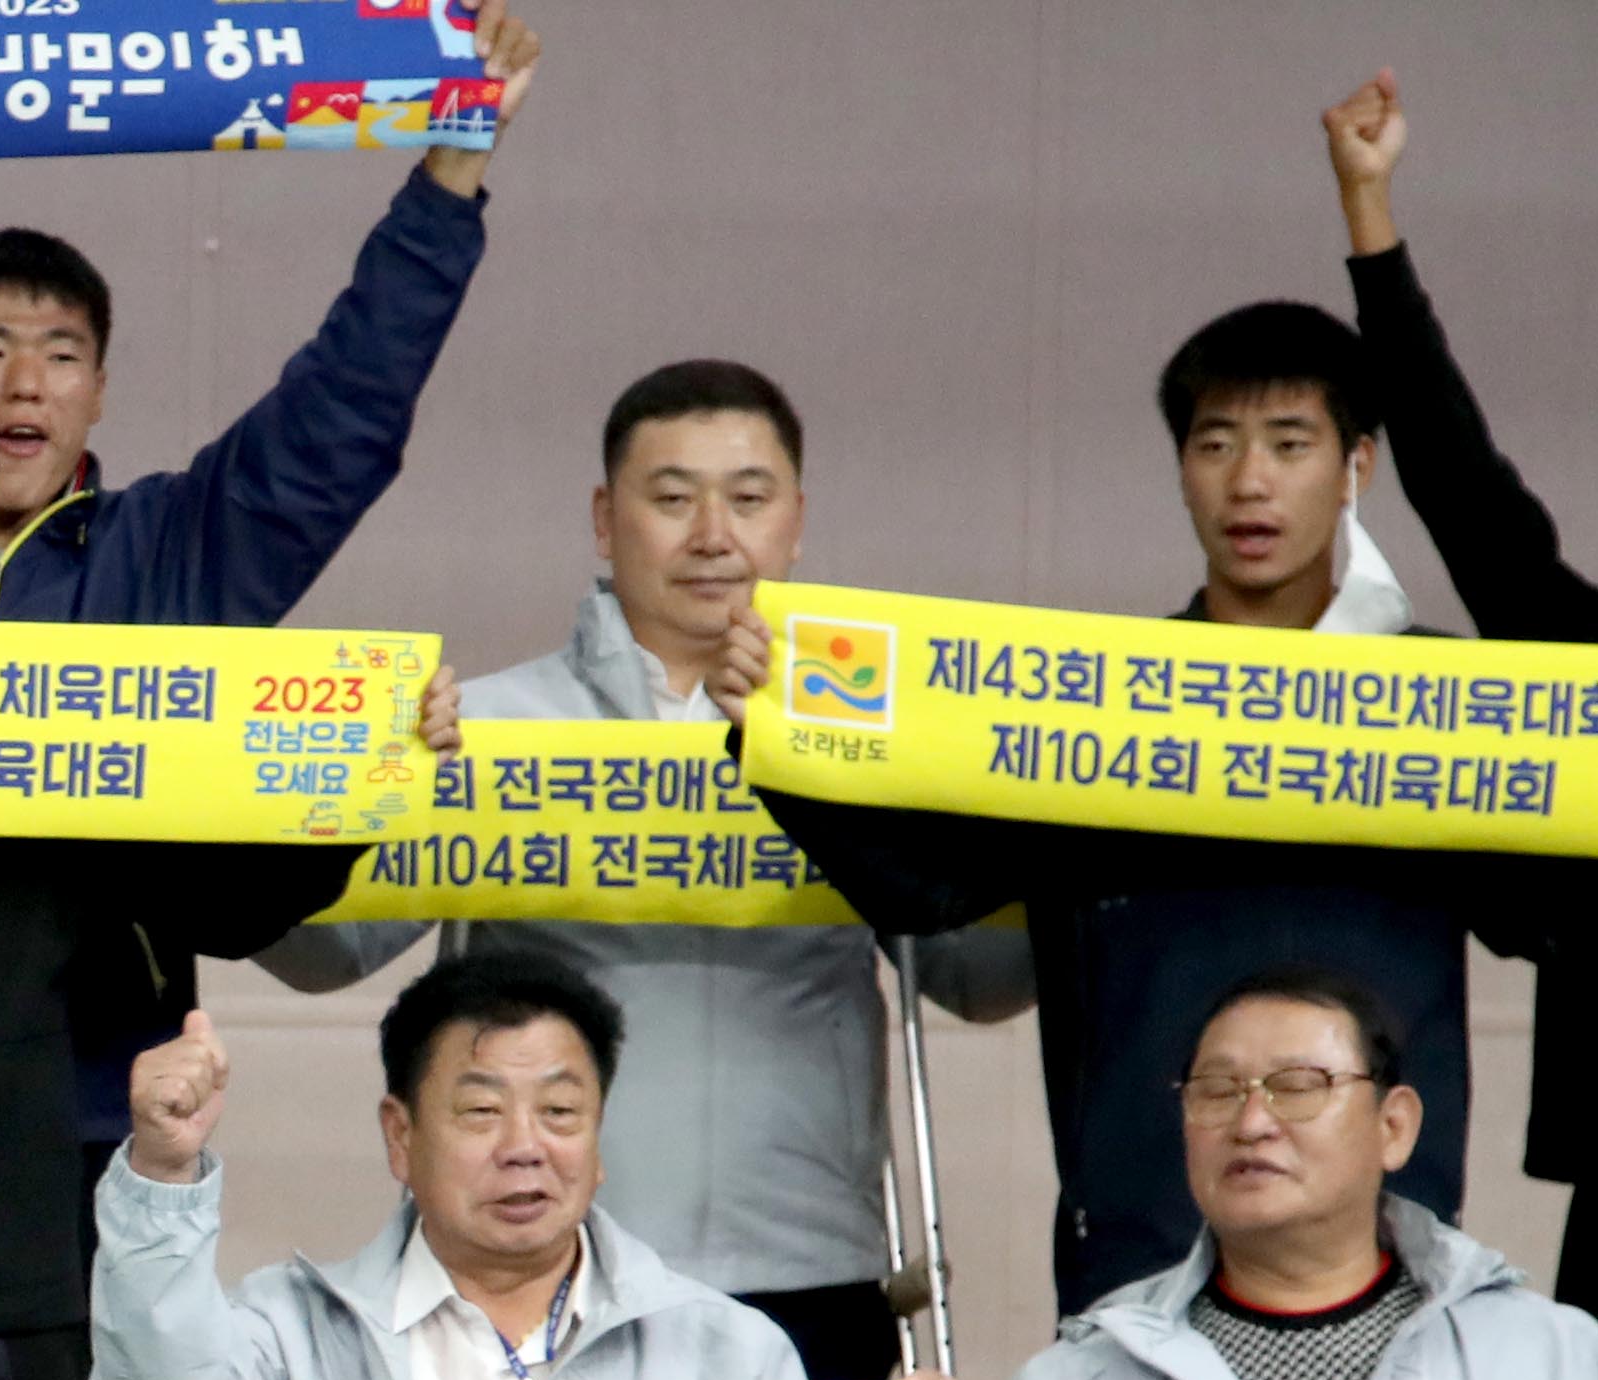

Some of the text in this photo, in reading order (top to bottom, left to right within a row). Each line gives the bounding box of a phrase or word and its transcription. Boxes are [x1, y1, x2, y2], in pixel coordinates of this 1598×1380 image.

[927, 637, 1106, 707] 제43회
[253, 676, 366, 713] 2023
[243, 720, 369, 754] 전남으로
[788, 728, 889, 762] 전라남도
[254, 762, 350, 796] 오세요
[989, 723, 1556, 816] 제104회 전국체육대회
[370, 833, 570, 888] 제104회
